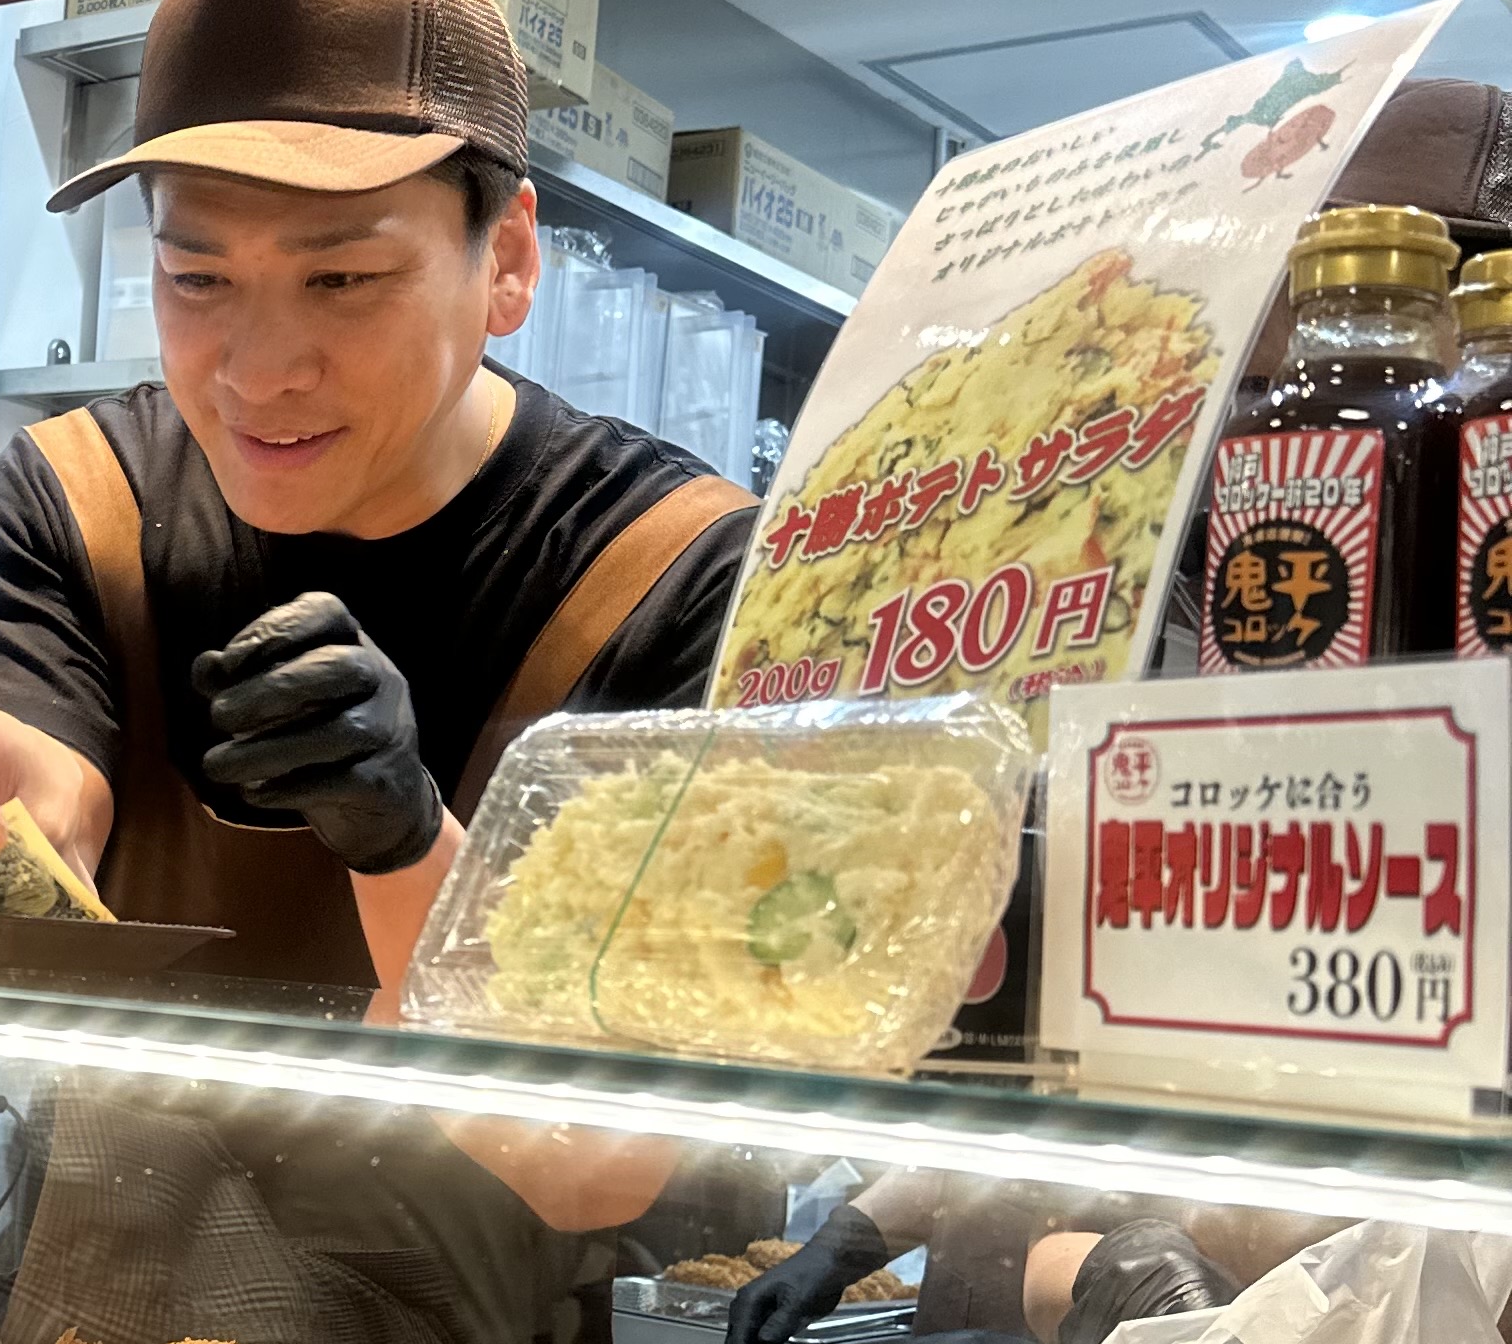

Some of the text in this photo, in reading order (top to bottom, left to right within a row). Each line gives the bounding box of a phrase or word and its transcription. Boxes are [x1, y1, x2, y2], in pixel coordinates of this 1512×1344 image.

[763, 384, 1208, 570] 十勝ポテトサラダ
[1220, 549, 1333, 612] 鬼平
[1222, 604, 1321, 647] コロッケ
[736, 657, 842, 709] 200g
[1170, 771, 1372, 812] コロッケに合う
